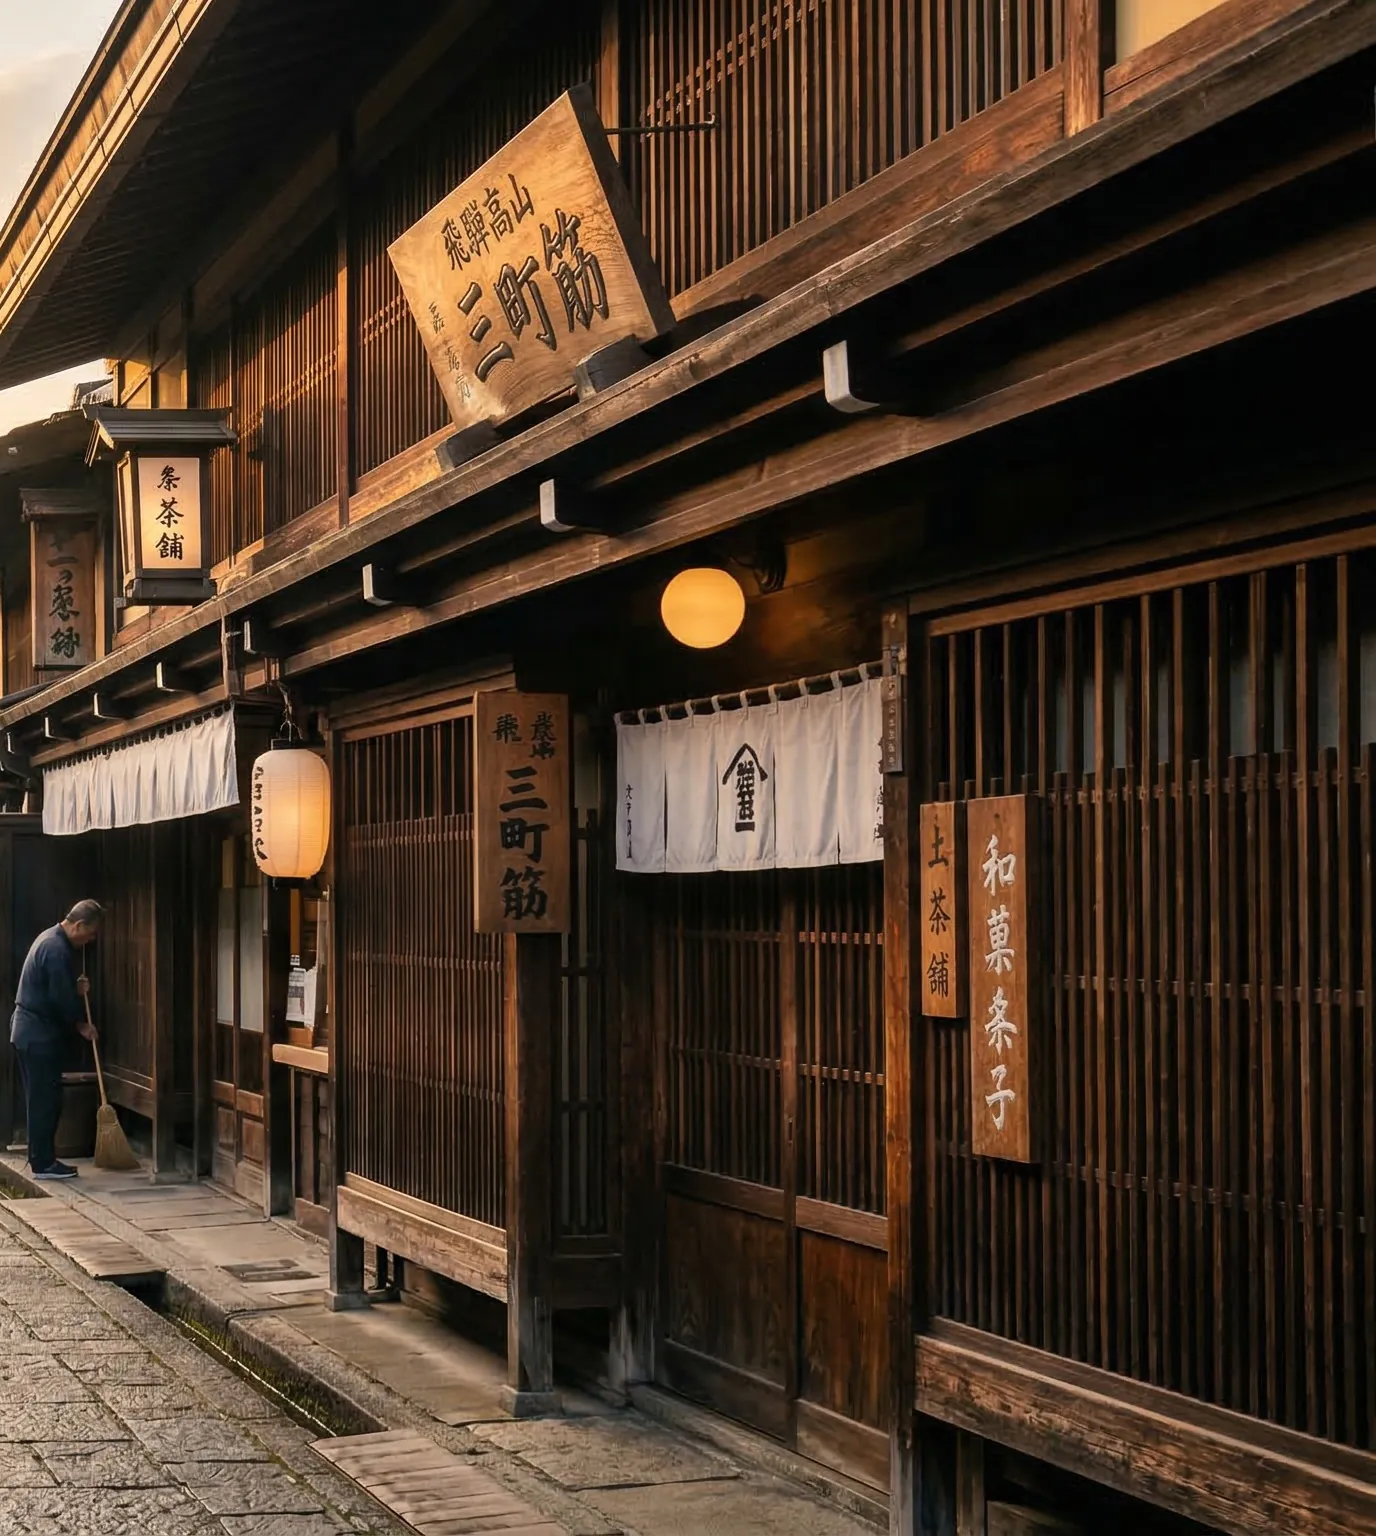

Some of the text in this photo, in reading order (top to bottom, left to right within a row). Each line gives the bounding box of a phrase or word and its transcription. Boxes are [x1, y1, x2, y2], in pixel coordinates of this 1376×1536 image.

[457, 207, 610, 384] 三町筋
[498, 765, 551, 921] 三町筋
